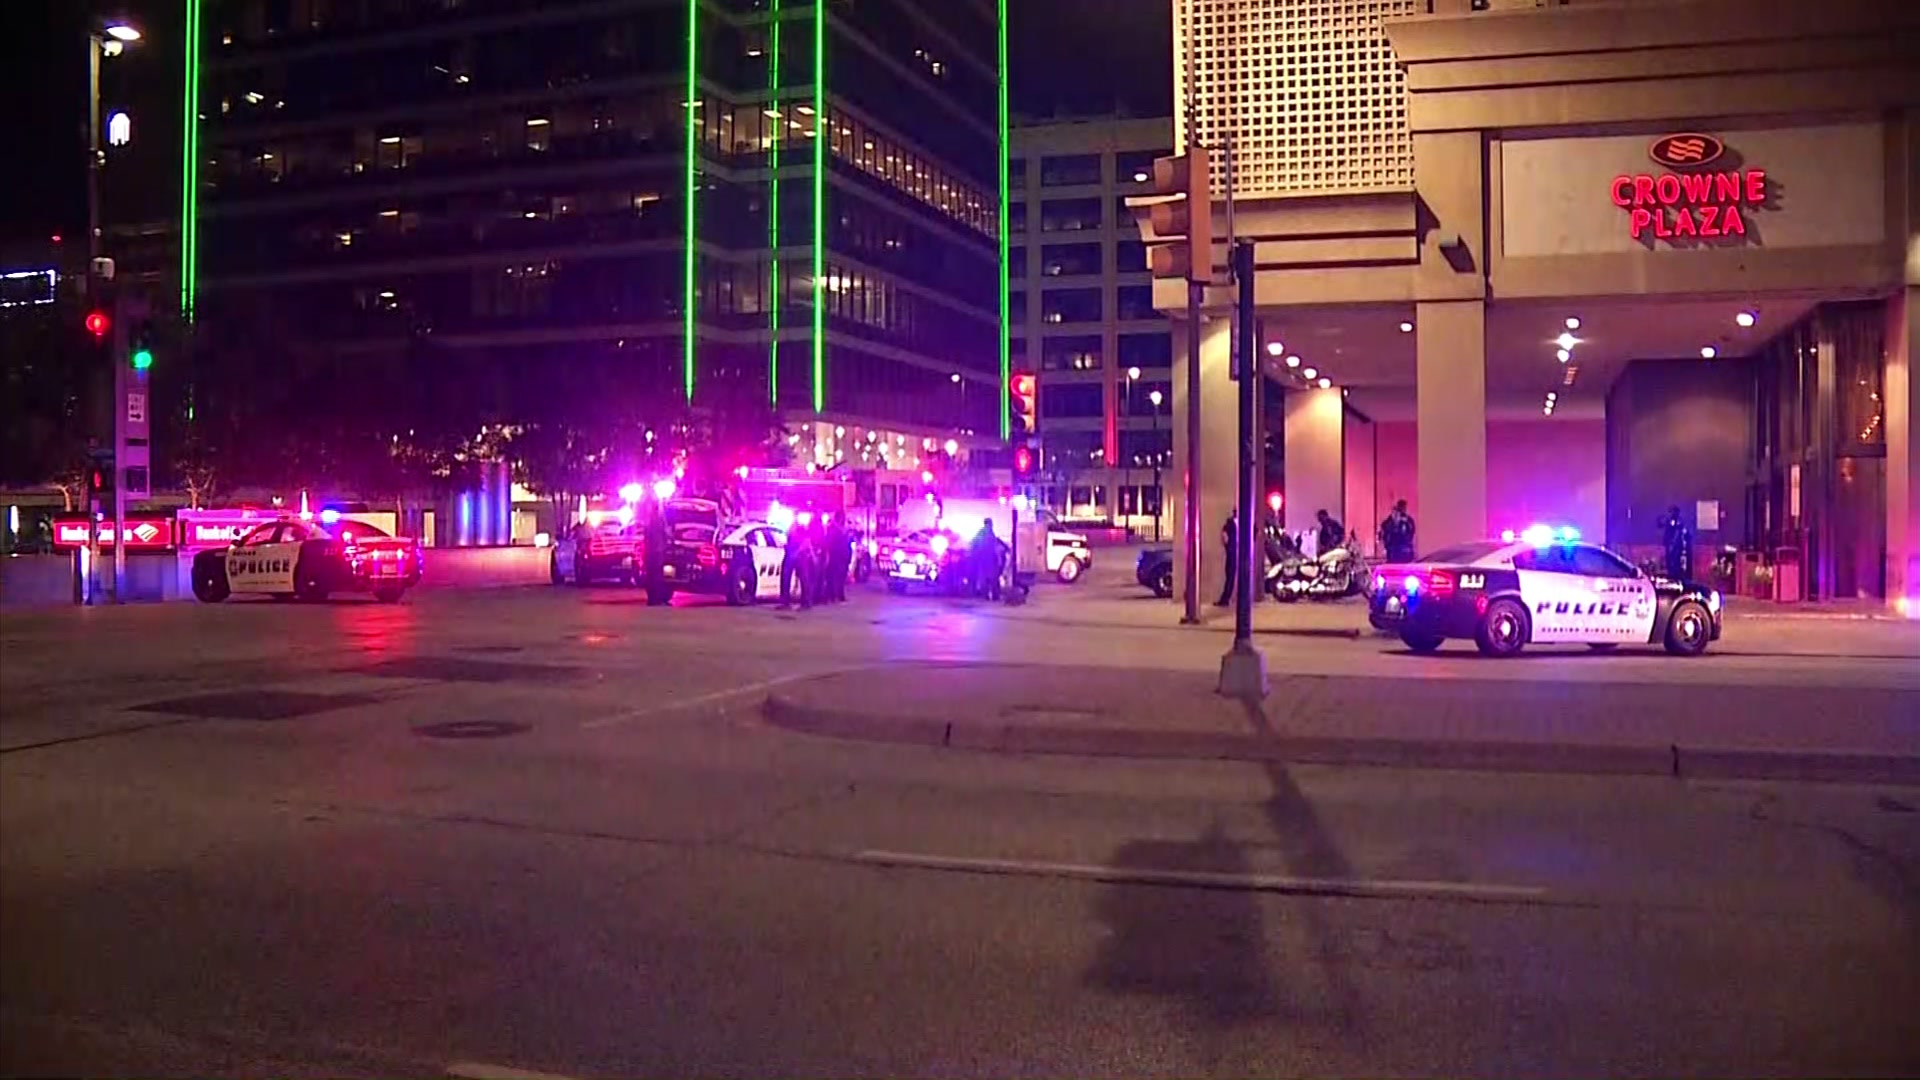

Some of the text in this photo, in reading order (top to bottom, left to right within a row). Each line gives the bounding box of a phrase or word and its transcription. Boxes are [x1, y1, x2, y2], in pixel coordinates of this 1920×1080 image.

[1610, 171, 1766, 206] CROWNE
[1631, 205, 1745, 238] PLAZA
[239, 559, 290, 574] POLICE
[1536, 602, 1630, 615] POLICE
